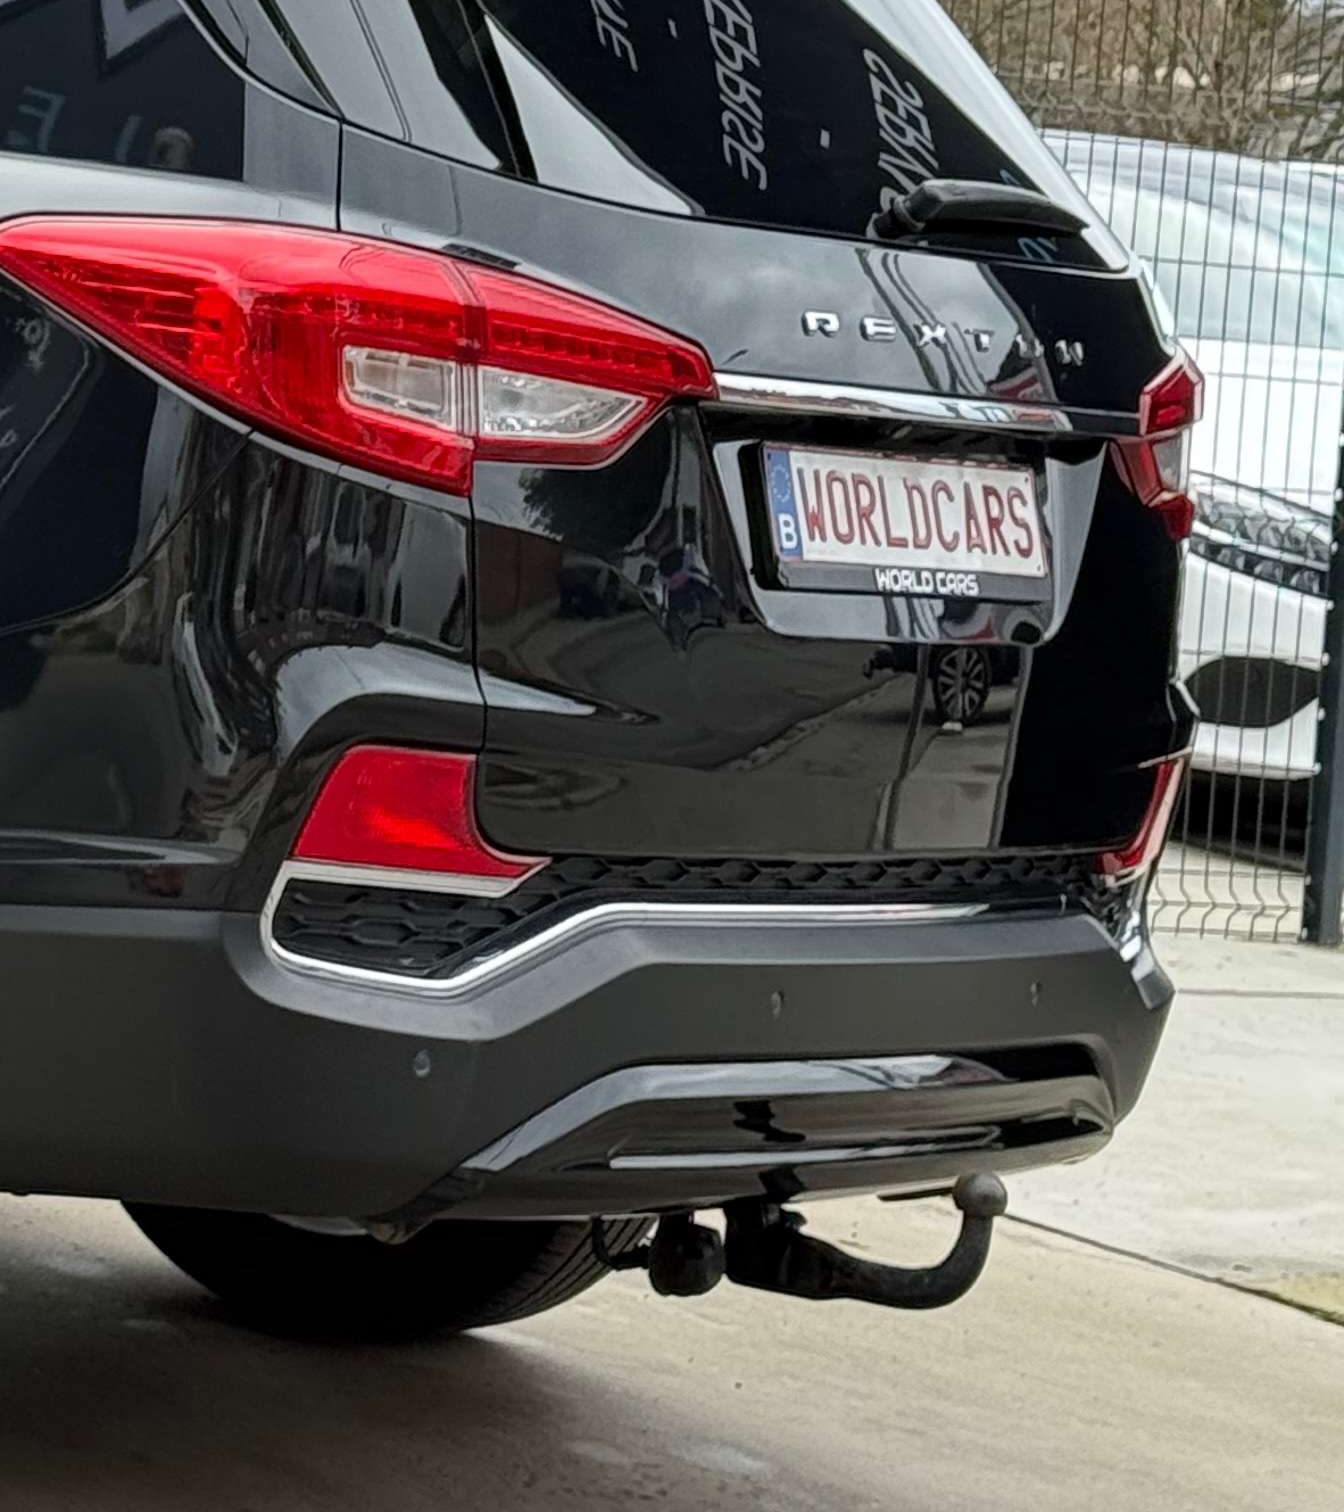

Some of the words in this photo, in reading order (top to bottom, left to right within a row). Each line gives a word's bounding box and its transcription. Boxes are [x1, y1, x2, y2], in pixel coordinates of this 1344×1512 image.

[777, 513, 799, 550] B
[796, 466, 1036, 559] WORLDCARS
[873, 568, 934, 594] WORLD
[934, 570, 980, 597] CARS
